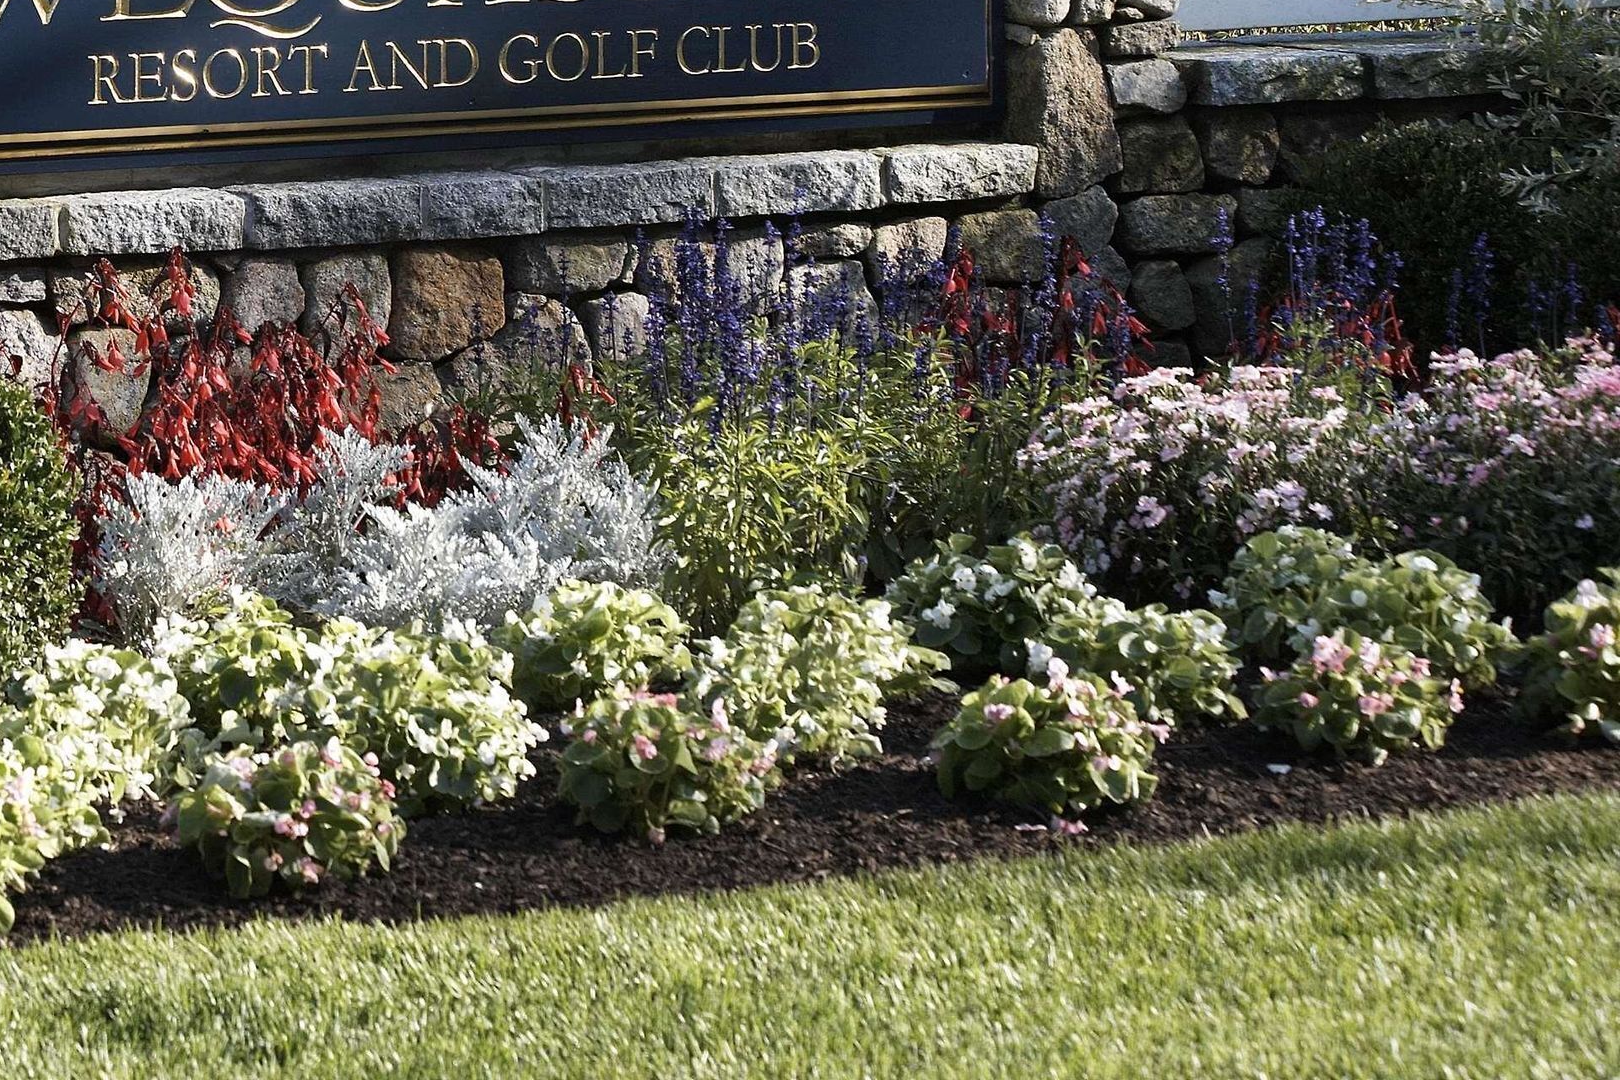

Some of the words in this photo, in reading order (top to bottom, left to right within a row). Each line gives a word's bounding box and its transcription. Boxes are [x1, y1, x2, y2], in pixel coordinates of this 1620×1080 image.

[87, 42, 329, 107] RESORT
[342, 34, 480, 93] AND
[498, 27, 660, 84] GOLF
[676, 21, 822, 75] CLUB
